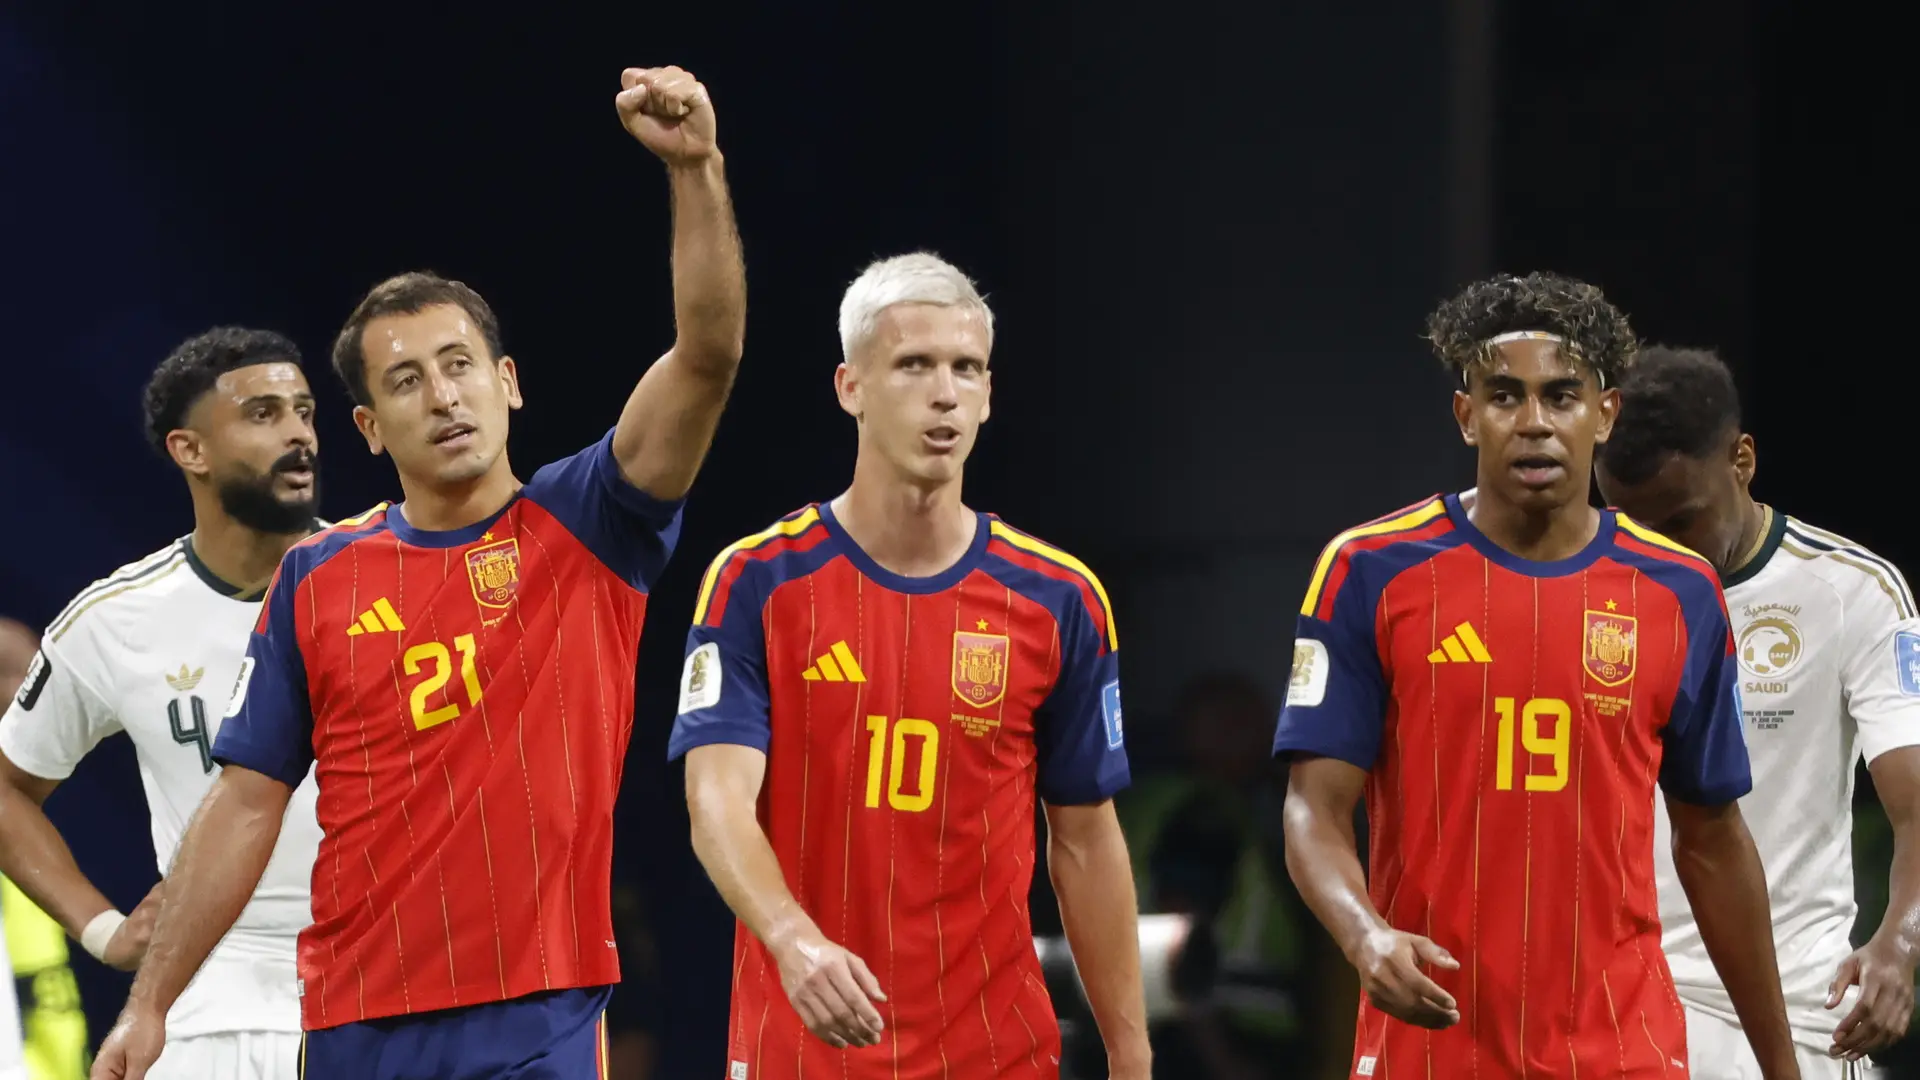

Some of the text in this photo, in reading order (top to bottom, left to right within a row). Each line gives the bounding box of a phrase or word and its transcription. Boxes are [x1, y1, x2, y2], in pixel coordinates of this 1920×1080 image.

[403, 632, 483, 731] 21
[1745, 682, 1788, 693] SAUDI
[167, 695, 214, 775] 4
[865, 715, 939, 812] 10
[1495, 697, 1571, 792] 19
